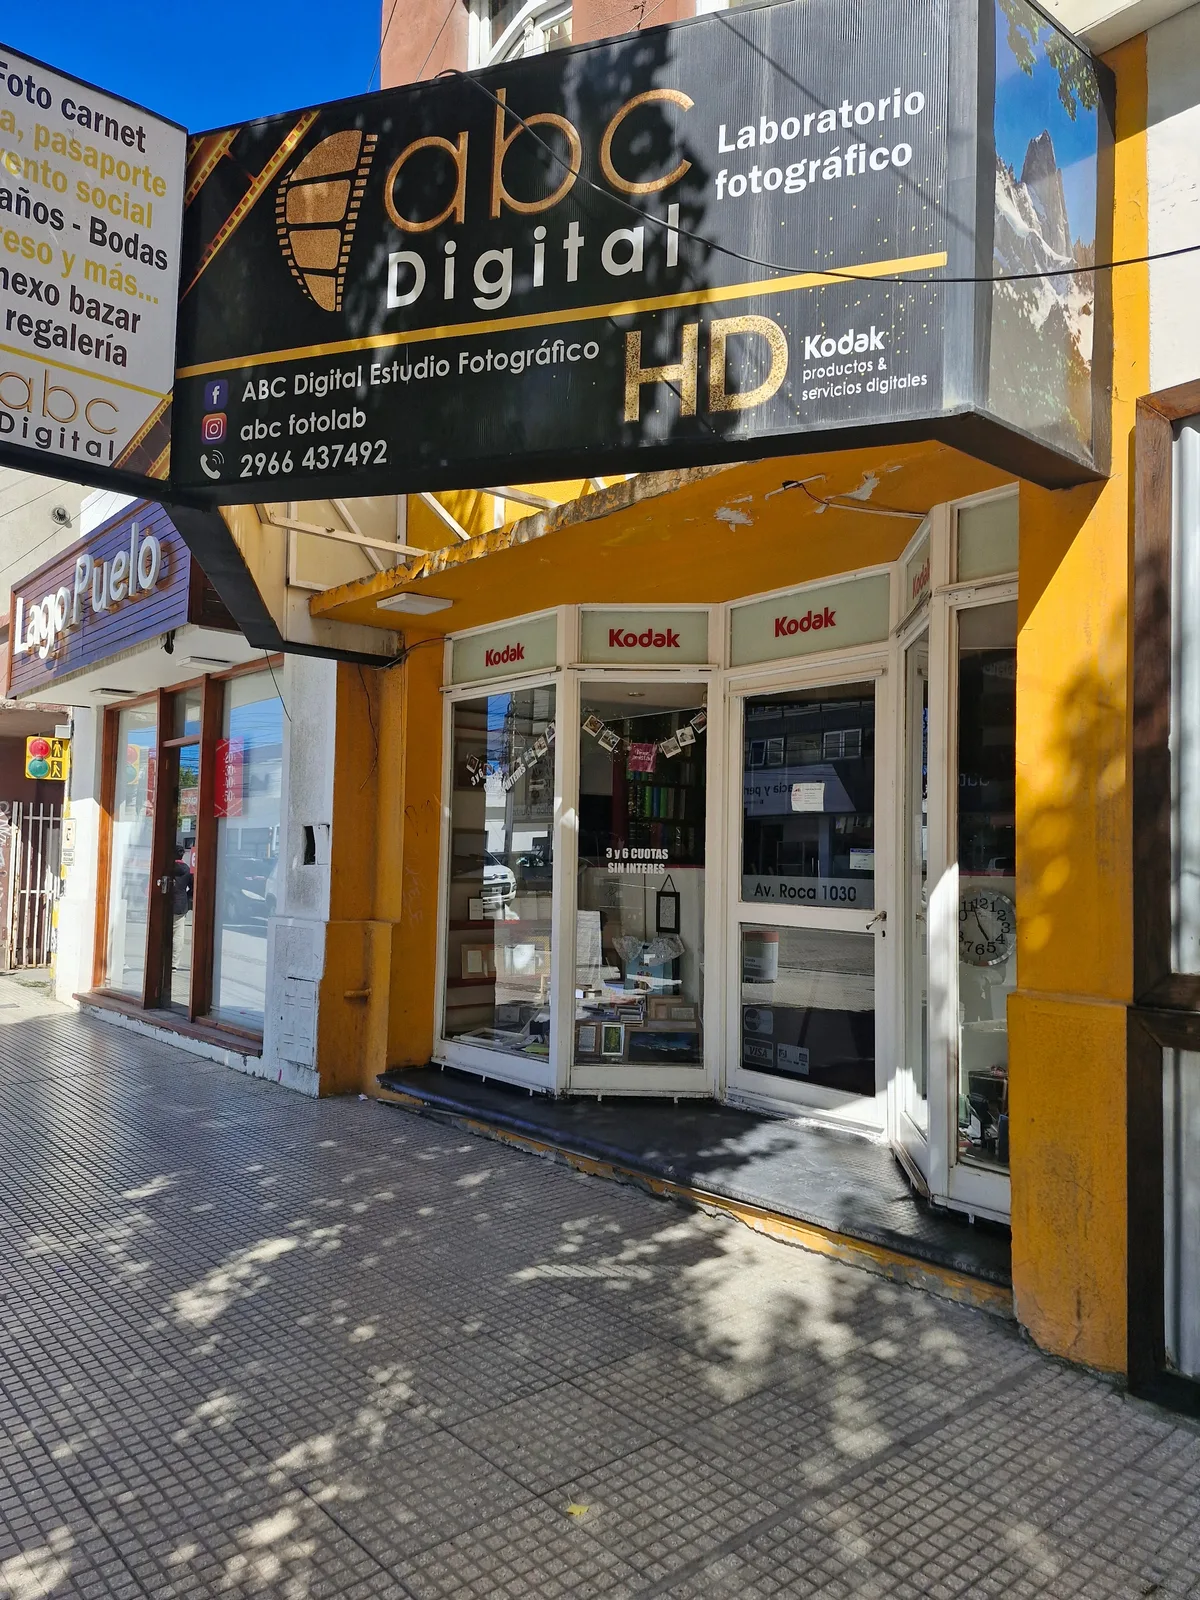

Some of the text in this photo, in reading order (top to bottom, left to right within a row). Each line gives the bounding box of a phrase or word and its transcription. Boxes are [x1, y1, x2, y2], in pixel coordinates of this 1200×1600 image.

[61, 98, 146, 153] carnet
[718, 87, 925, 154] Laboratorio
[34, 123, 166, 197] pasaporte
[384, 87, 695, 233] abc
[715, 142, 913, 200] fotográfico
[76, 180, 153, 228] social
[89, 216, 168, 270] Bodas
[386, 202, 680, 311] Digital
[61, 249, 76, 279] y
[84, 257, 158, 304] más...
[70, 285, 141, 334] bazar
[6, 308, 127, 367] regalería
[804, 325, 886, 360] Kodak
[241, 338, 600, 402] ABC Digital Estudio Fotográfico
[624, 314, 789, 422] HD
[802, 356, 888, 383] productos &
[802, 372, 928, 401] servicios digitales
[0, 369, 119, 435] abc
[0, 411, 114, 461] Digital
[240, 406, 367, 441] abc fotolab
[239, 439, 388, 478] 2966 437492
[14, 521, 163, 659] Lago Puelo
[608, 628, 681, 648] Kodak
[774, 606, 837, 638] Kodak
[485, 642, 525, 667] Kodak
[605, 848, 669, 860] 3 y 6 CUOTAS
[607, 863, 665, 875] SIN INTERES
[754, 883, 857, 902] Av. Roca 1030
[990, 901, 997, 912] 1
[997, 910, 1007, 921] 2
[1001, 922, 1011, 934] 3
[964, 941, 974, 952] 7
[975, 944, 985, 955] 6
[987, 942, 996, 953] 5
[995, 933, 1005, 945] 4
